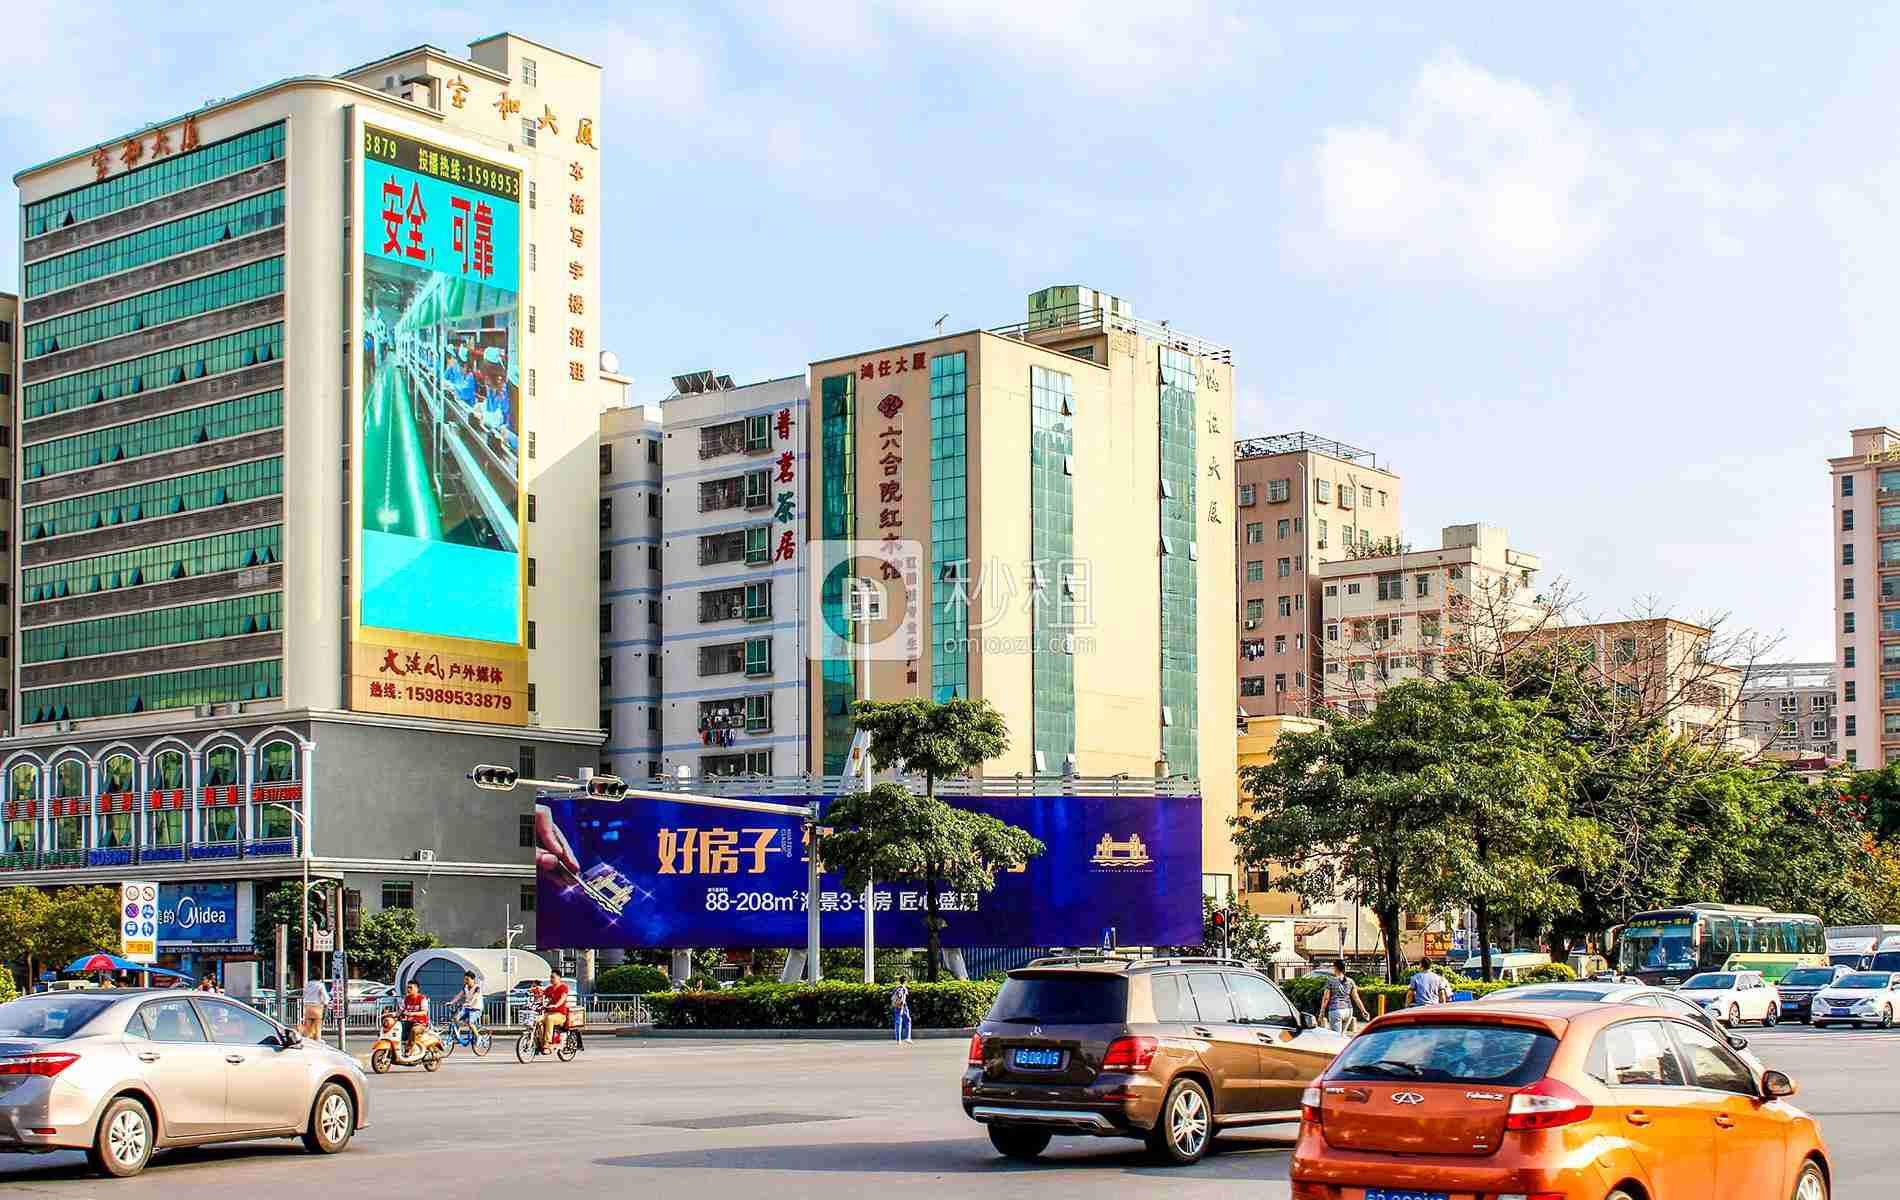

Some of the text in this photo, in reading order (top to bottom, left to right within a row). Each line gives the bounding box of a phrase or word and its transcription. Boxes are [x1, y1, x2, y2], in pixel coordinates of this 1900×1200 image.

[365, 133, 397, 160] 3879
[657, 827, 782, 875] 好房子
